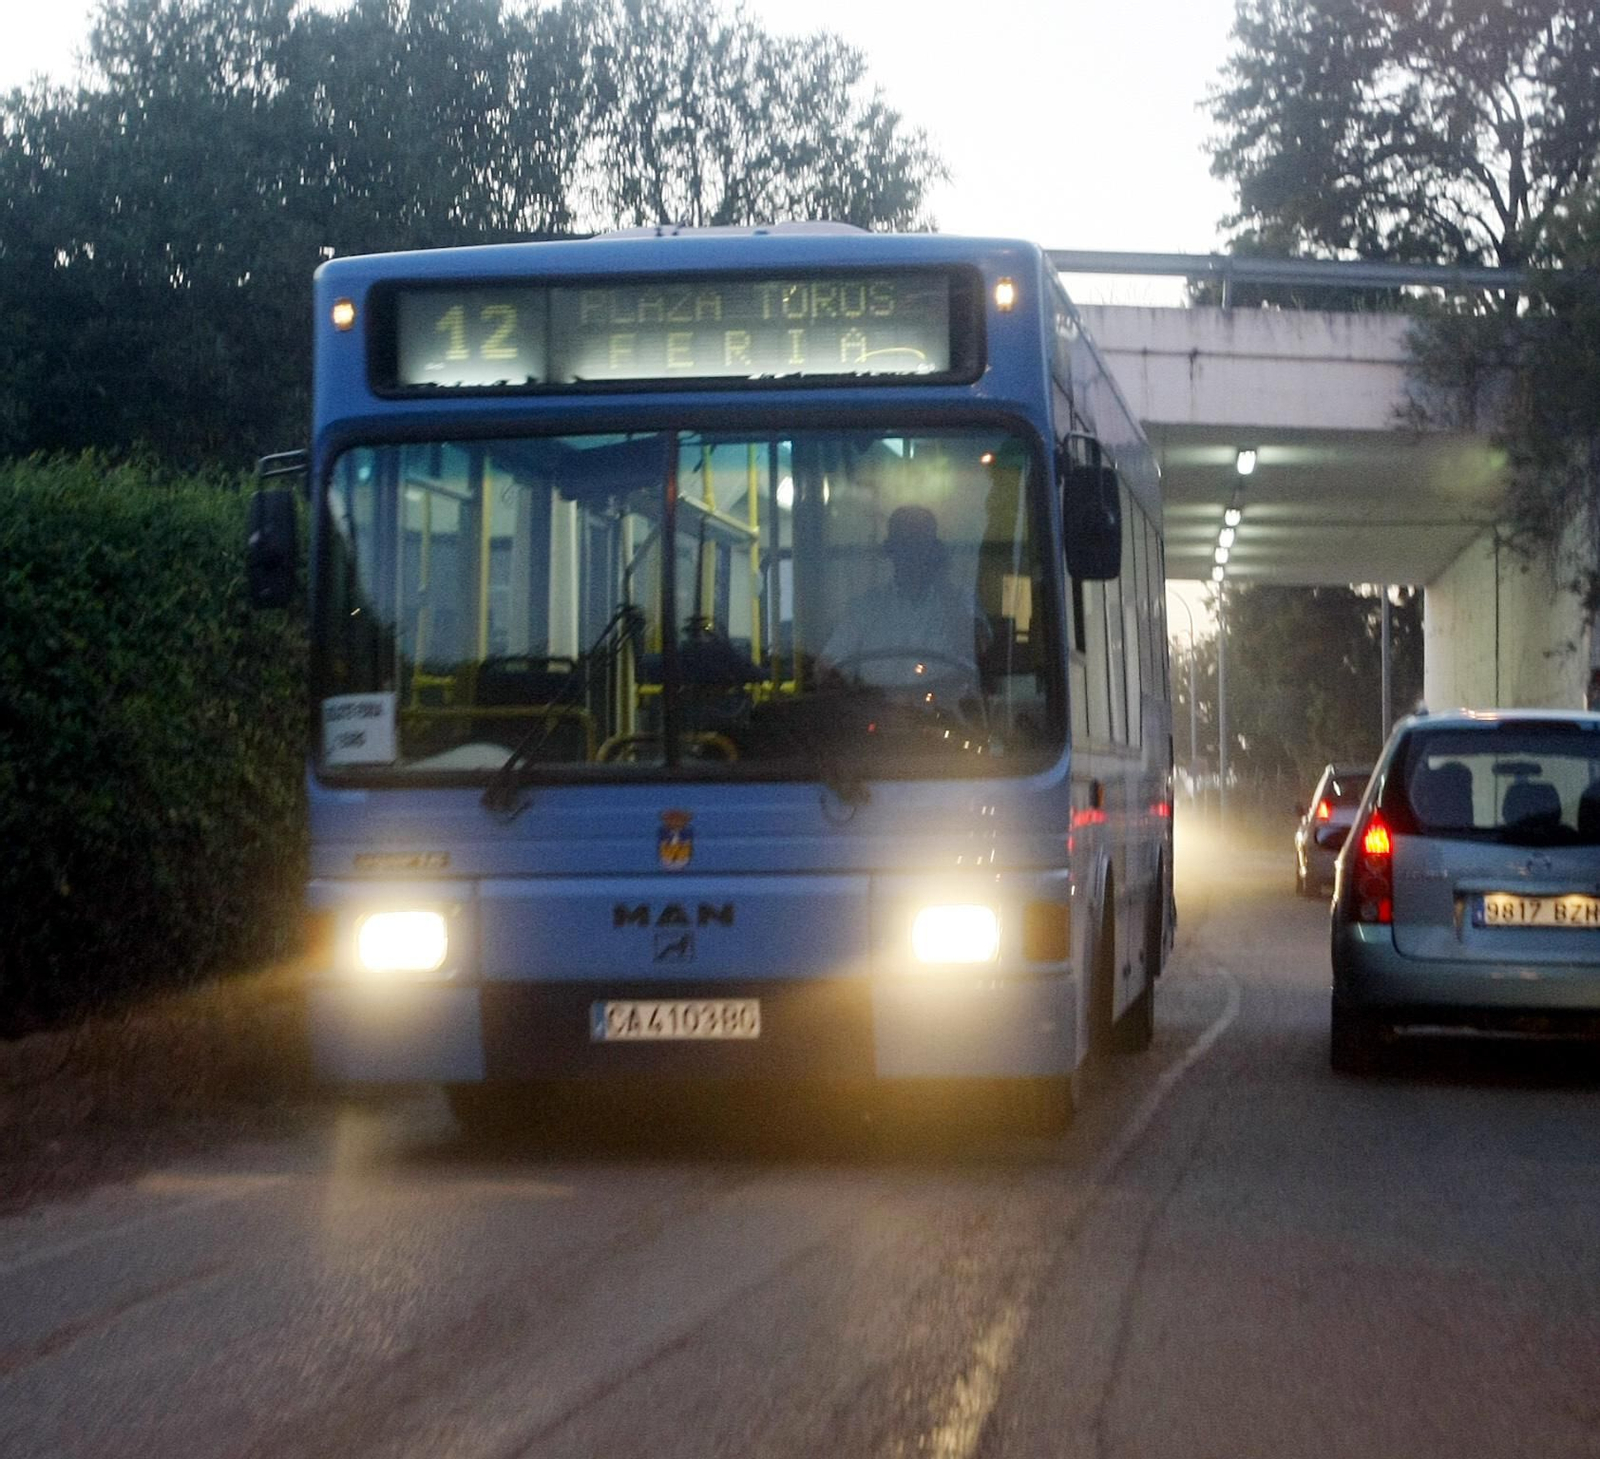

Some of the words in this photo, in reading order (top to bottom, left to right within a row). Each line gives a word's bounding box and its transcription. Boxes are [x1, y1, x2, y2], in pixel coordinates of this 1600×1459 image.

[582, 287, 722, 323] PLAZA
[435, 304, 518, 361] 12
[609, 327, 867, 370] FERIA
[612, 903, 735, 927] MAN
[1487, 899, 1541, 921] 9817
